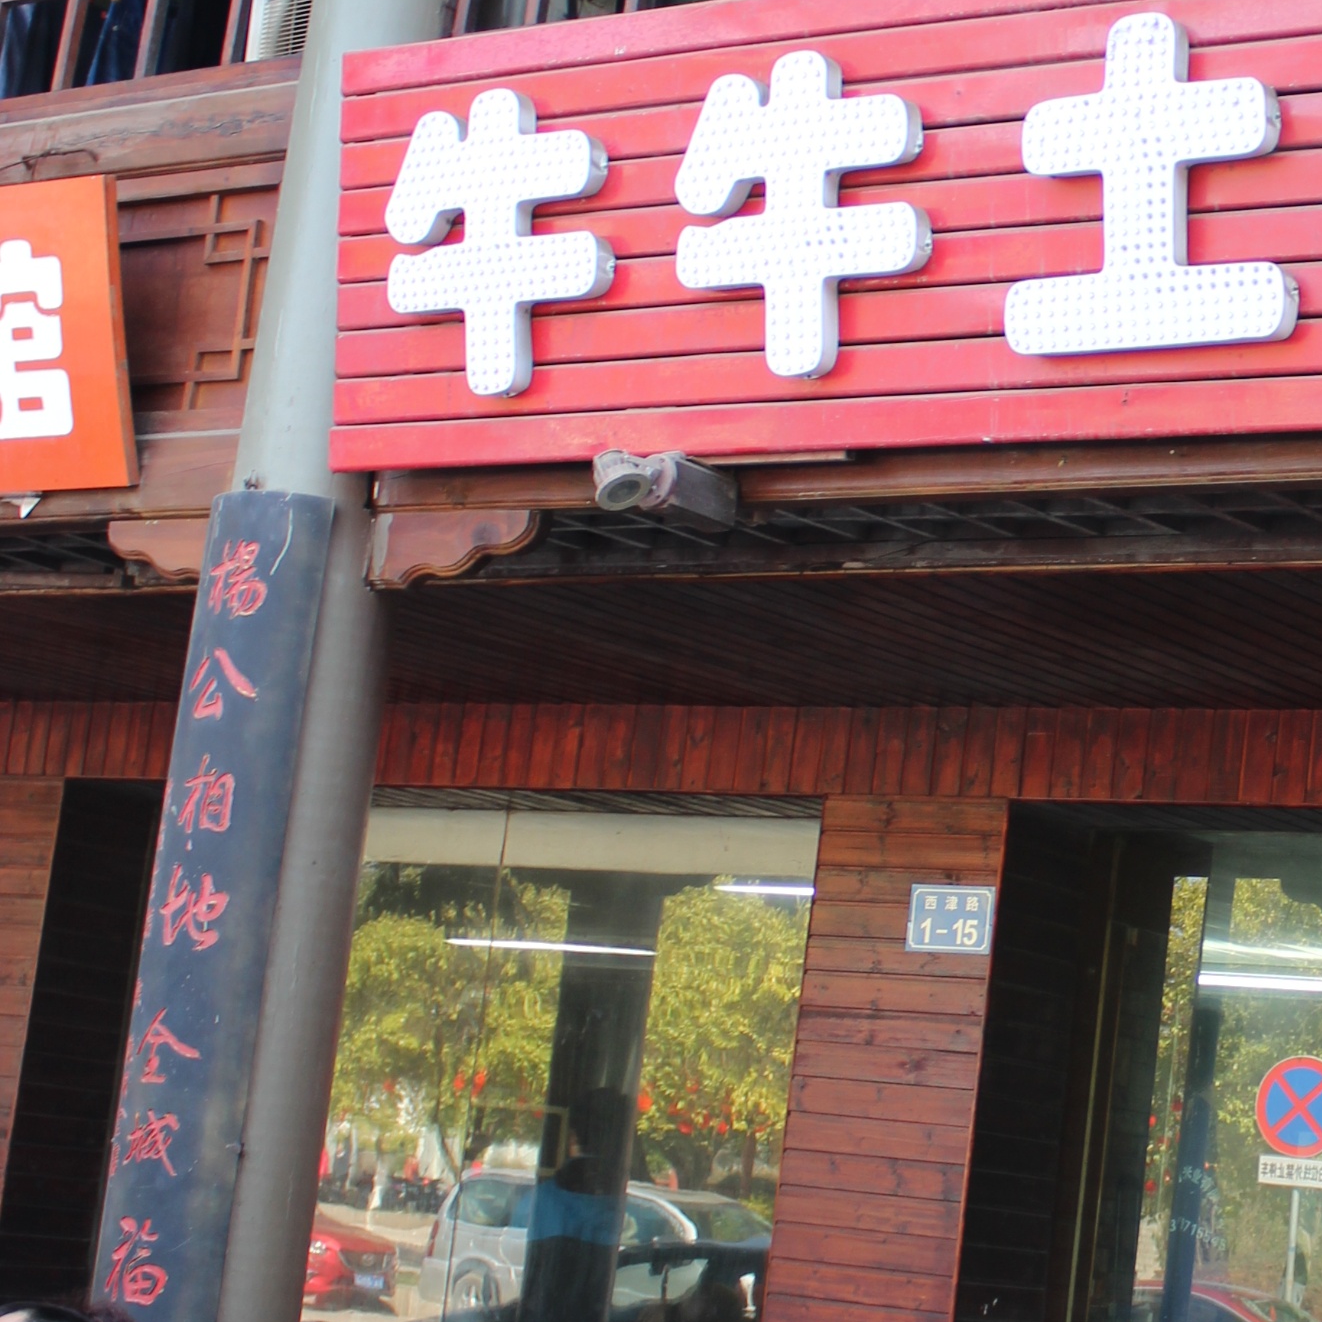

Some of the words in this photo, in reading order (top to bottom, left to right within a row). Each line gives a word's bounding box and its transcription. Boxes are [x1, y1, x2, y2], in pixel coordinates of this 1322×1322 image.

[924, 895, 979, 912] 西津路
[920, 917, 979, 946] 1-15
